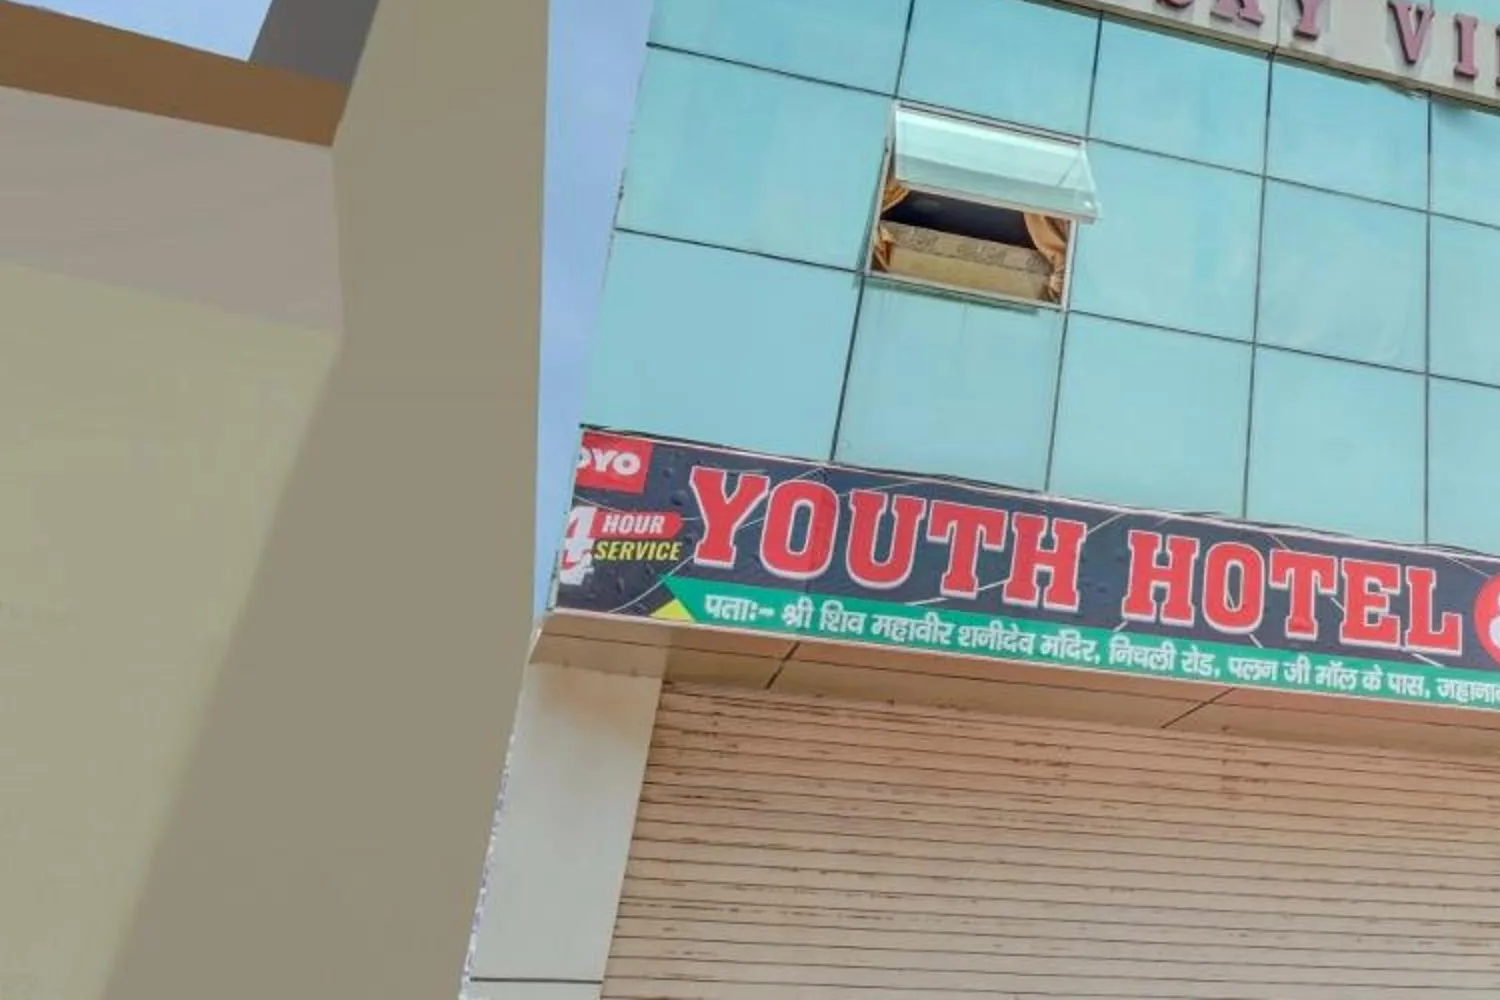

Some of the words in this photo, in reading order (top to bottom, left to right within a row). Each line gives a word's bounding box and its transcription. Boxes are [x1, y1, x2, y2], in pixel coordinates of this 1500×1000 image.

[594, 540, 683, 562] SERVICE
[601, 513, 666, 535] HOUR
[688, 465, 1088, 612] YOUTH
[1121, 529, 1463, 656] HOTEL
[820, 599, 867, 635] शिव
[871, 611, 956, 645] महावीर
[1362, 663, 1383, 691] के
